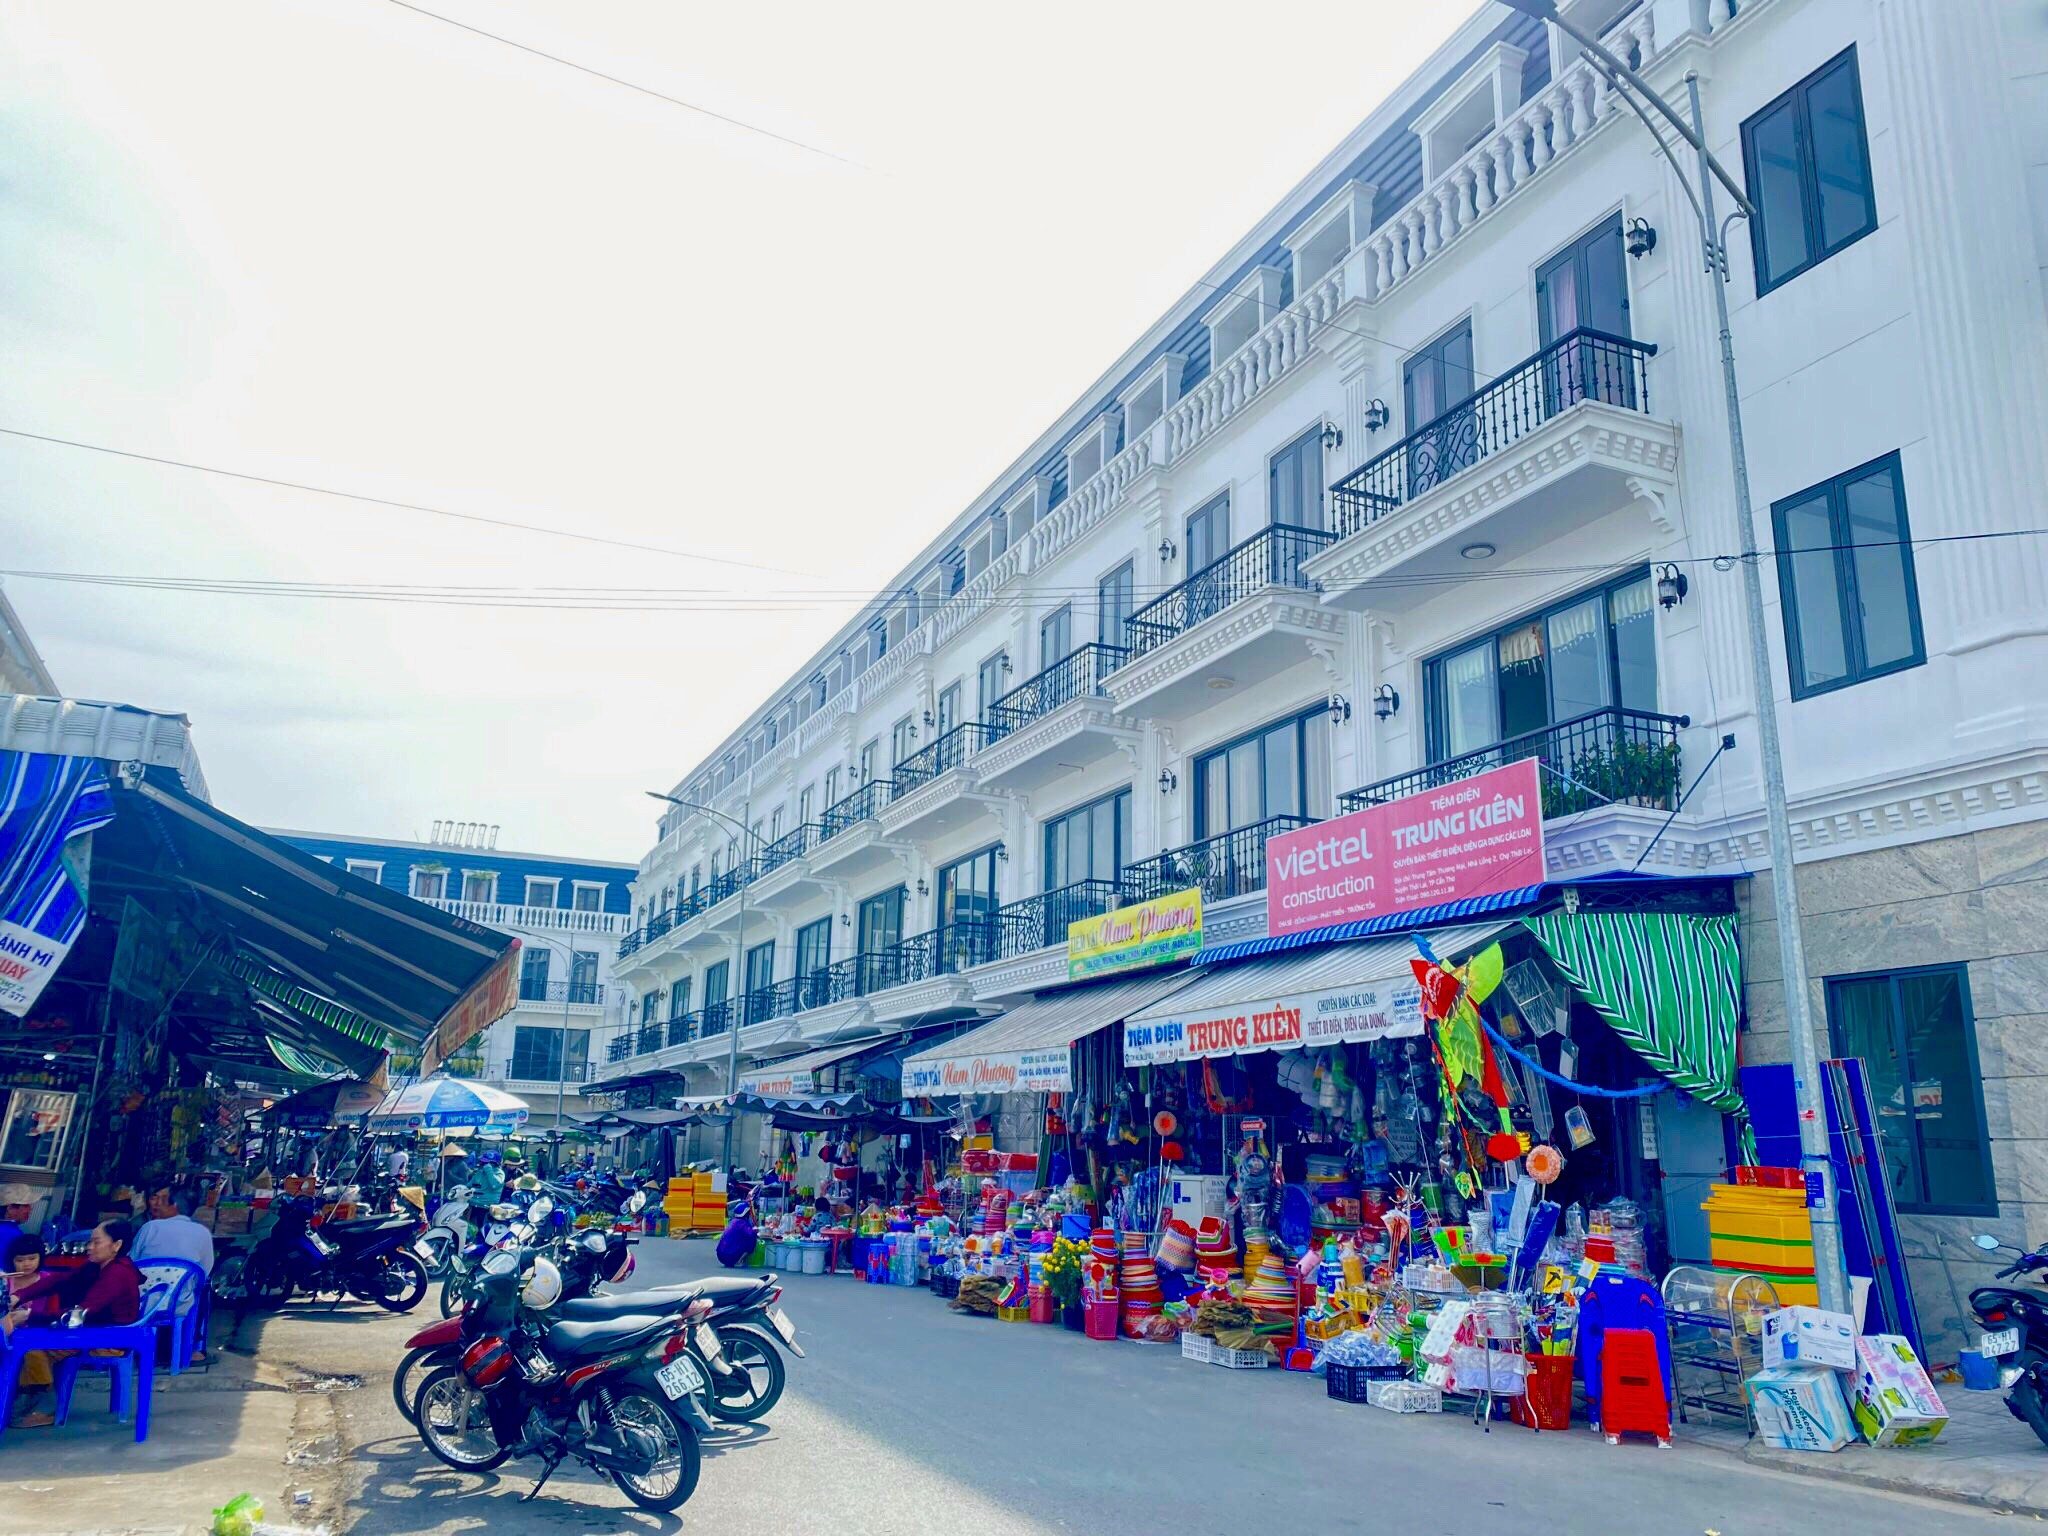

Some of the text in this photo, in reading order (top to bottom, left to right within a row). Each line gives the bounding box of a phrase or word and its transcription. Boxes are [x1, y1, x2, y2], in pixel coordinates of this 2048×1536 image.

[1430, 787, 1480, 811] TIỆM ĐIỆN
[1391, 792, 1524, 851] TRUNG KIÊN
[1282, 875, 1375, 909] construction
[1100, 917, 1134, 946] Nam
[0, 932, 32, 958] ÁNH
[1350, 992, 1361, 1007] CÁC
[1127, 1003, 1301, 1052] TIỆM ĐIỆN TRUNG KIÊN
[1358, 1015, 1369, 1031] GIA
[943, 1061, 969, 1085] Nam
[972, 1058, 1017, 1088] Phương
[445, 1115, 462, 1124] VNPT
[661, 1361, 689, 1382] 65-H1
[666, 1371, 701, 1397] 266.12
